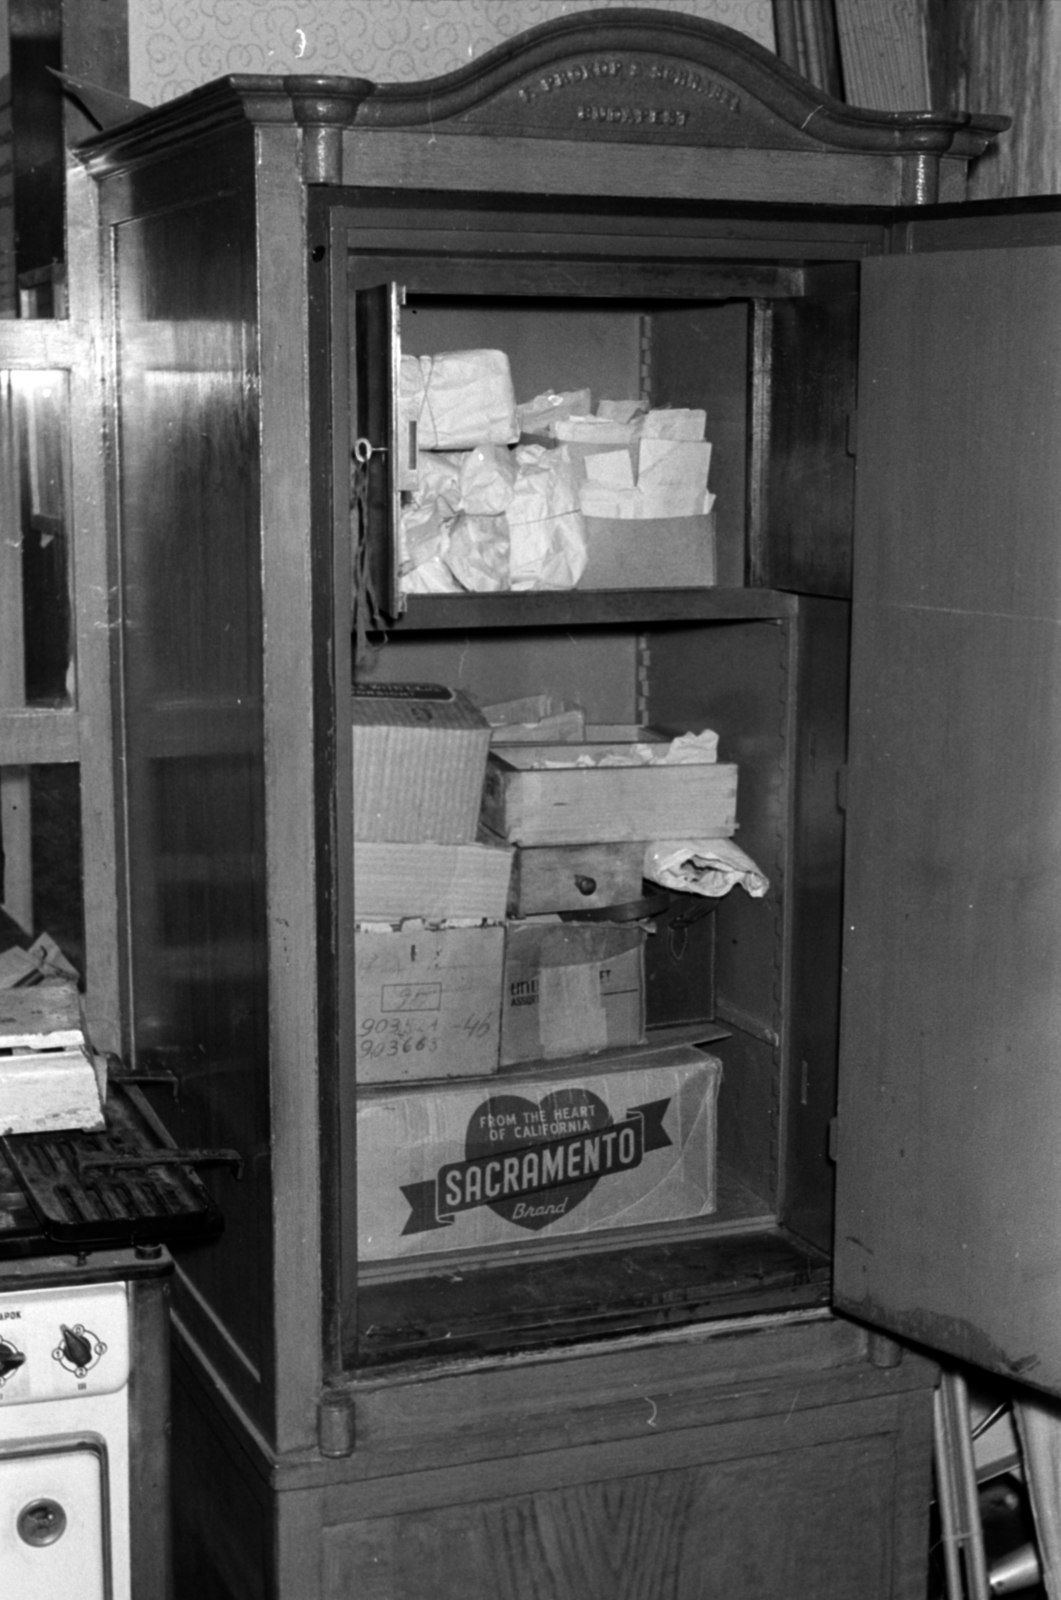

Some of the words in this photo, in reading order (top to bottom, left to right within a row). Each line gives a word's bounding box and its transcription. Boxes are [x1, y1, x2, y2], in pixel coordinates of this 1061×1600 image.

[577, 105, 691, 126] BUDAPEST
[480, 1113, 517, 1130] FROM
[523, 1109, 547, 1125] THE
[554, 1104, 596, 1121] HEART
[489, 1127, 506, 1141] OF
[514, 1120, 591, 1139] CALIFORNIA
[445, 1127, 635, 1206] SACRAMENTO
[511, 1197, 569, 1220] Brand
